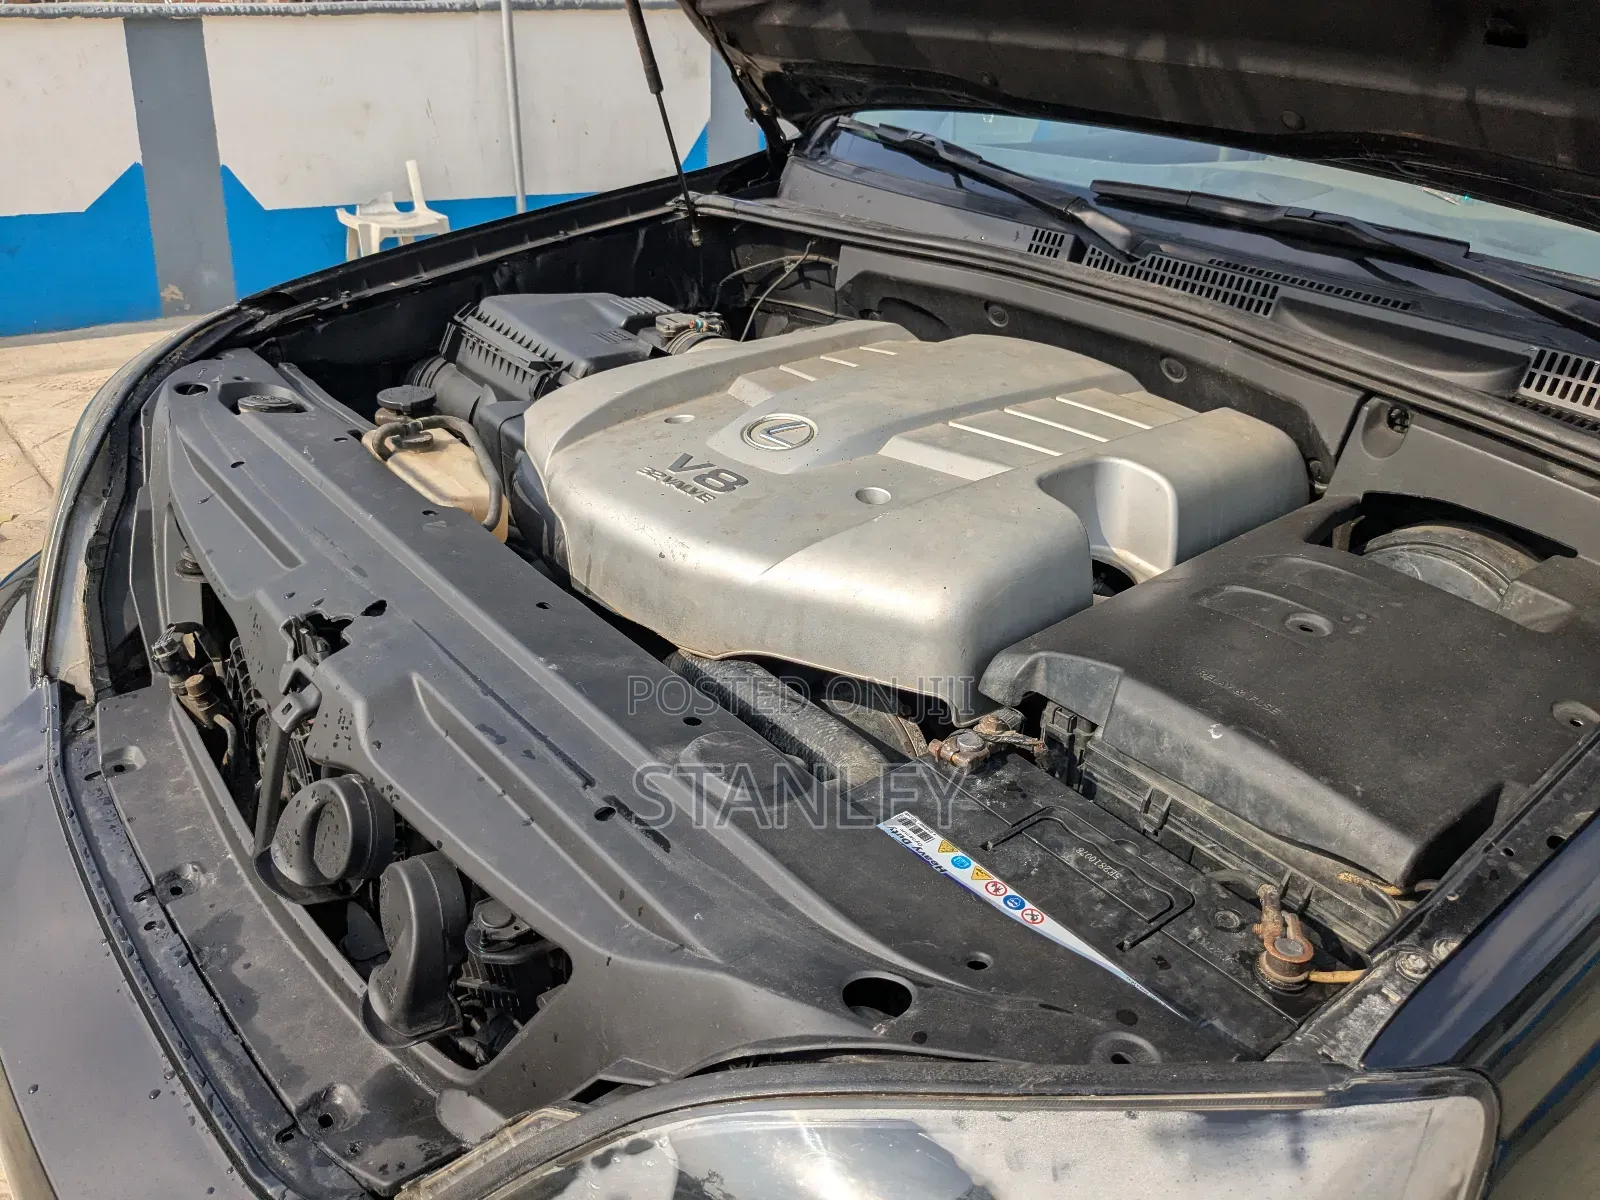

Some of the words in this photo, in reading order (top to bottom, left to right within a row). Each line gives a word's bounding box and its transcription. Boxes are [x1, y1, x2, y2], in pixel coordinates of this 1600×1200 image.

[666, 452, 749, 493] V8
[661, 475, 717, 504] VALVE
[1246, 695, 1282, 715] FUSE
[887, 826, 912, 845] Duty
[912, 846, 948, 873] Heavy
